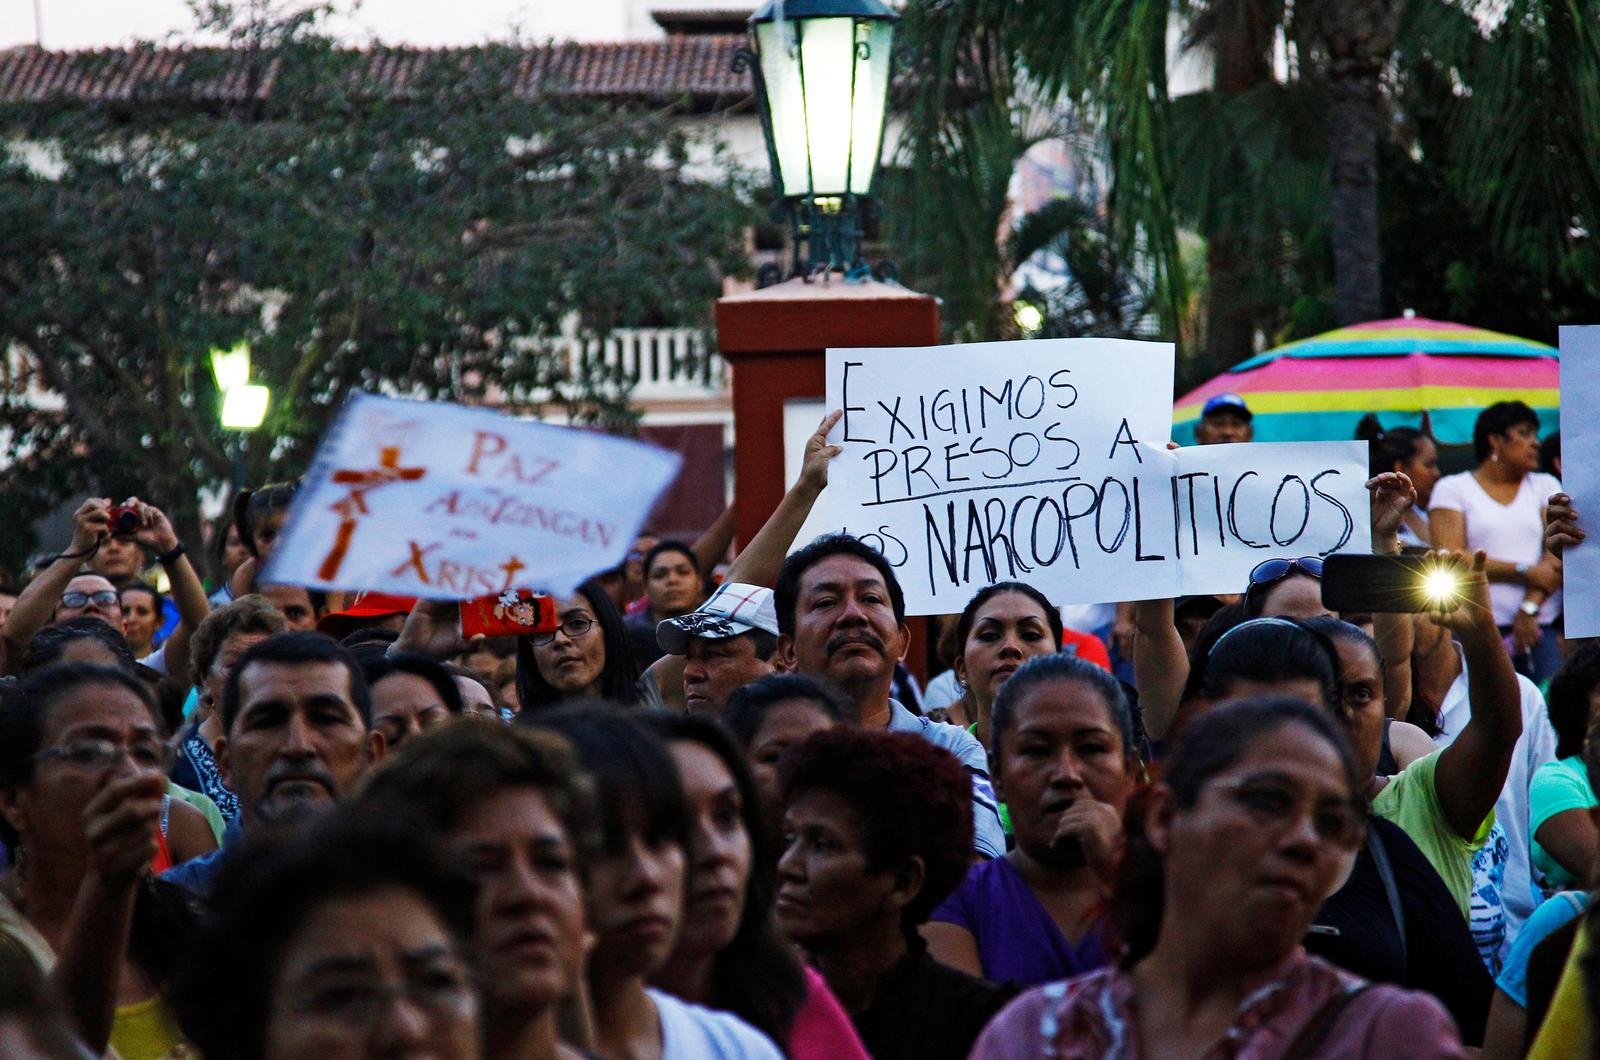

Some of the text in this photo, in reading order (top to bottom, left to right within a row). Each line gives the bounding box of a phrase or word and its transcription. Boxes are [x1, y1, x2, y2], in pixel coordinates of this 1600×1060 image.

[843, 361, 1078, 444] EXIGIMOS
[464, 429, 560, 484] PAZ
[862, 418, 1143, 503] PRESOS A
[843, 469, 1354, 596] OS NARCOPOLITICOS
